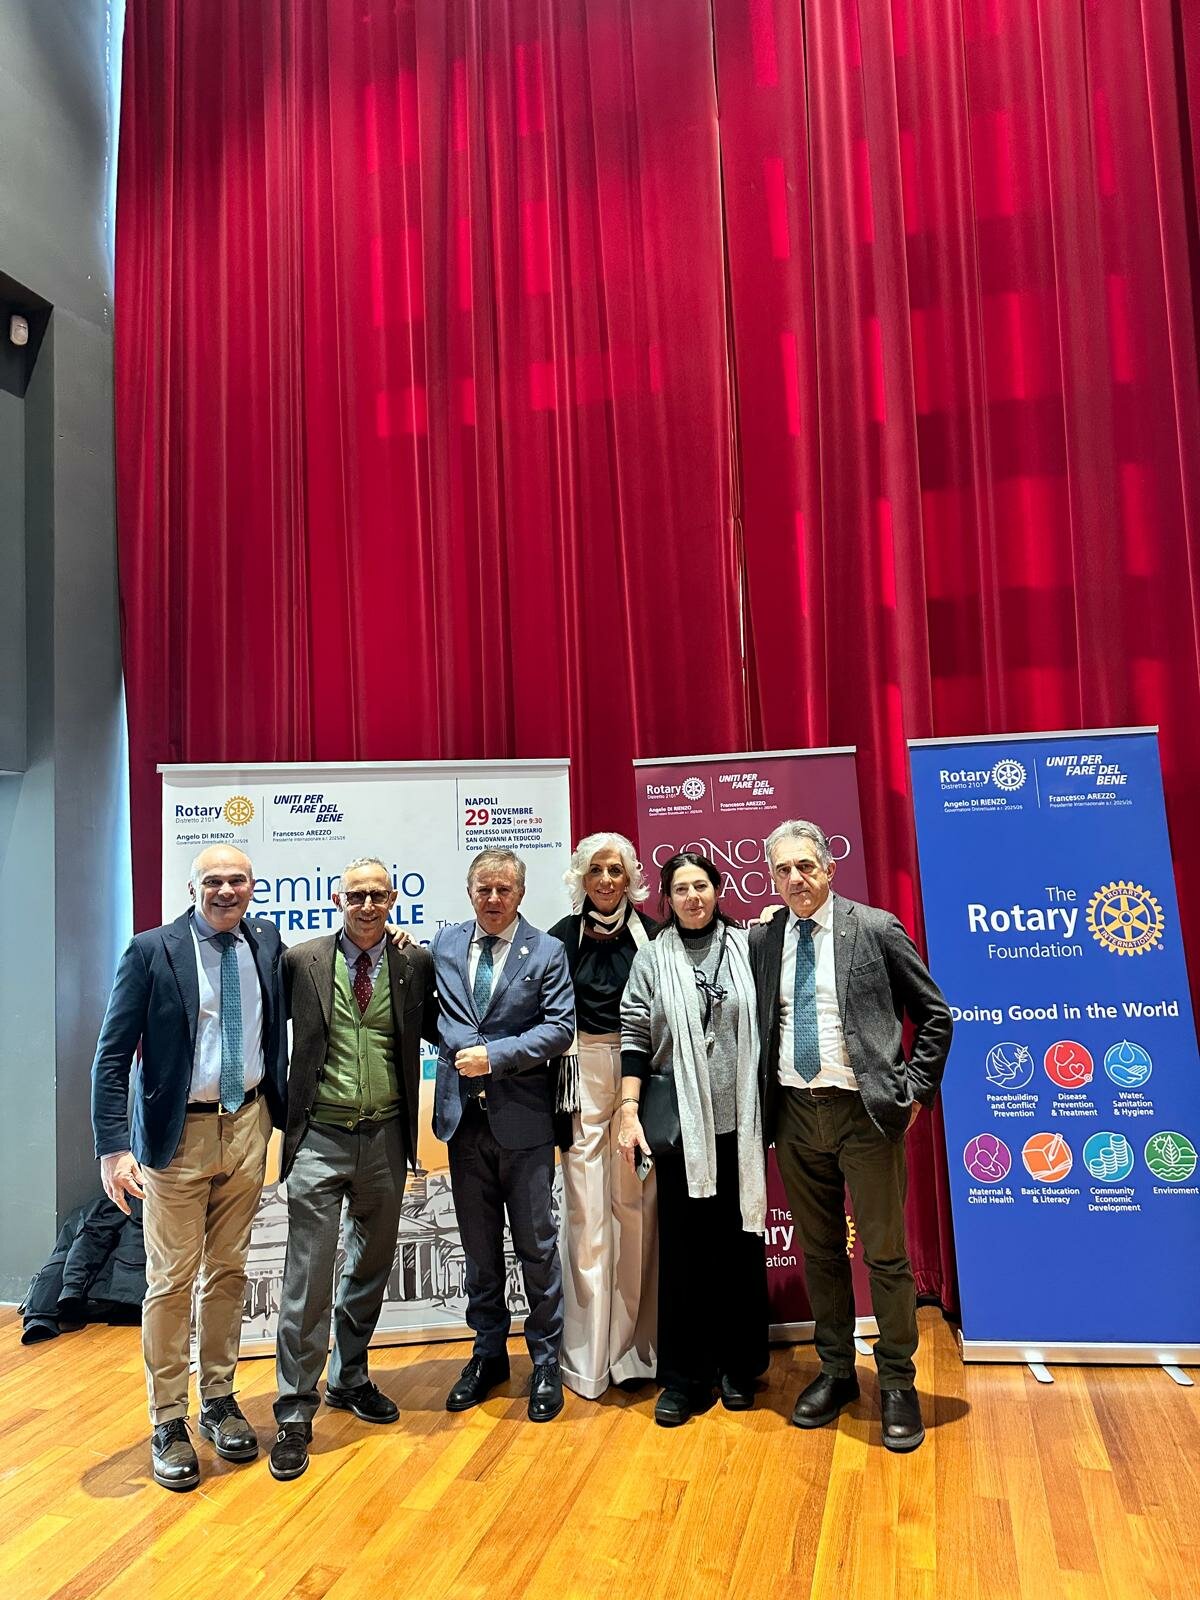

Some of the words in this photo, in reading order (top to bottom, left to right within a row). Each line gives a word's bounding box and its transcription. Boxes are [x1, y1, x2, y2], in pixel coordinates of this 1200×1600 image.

[1046, 755, 1078, 767] UNITI
[1080, 754, 1102, 765] PER
[1066, 765, 1096, 776] FARE
[1098, 764, 1121, 775] DEL
[719, 774, 740, 782] UNITI
[742, 773, 757, 781] PER
[939, 769, 991, 784] Rotary
[1096, 774, 1128, 785] BENE
[646, 784, 682, 795] Rotary
[732, 781, 753, 789] FARE
[754, 780, 770, 788] DEL
[752, 787, 774, 795] BENE
[273, 794, 302, 804] UNITI
[303, 794, 323, 804] PER
[465, 797, 498, 806] NAPOLI
[1049, 794, 1085, 803] Francesco
[1087, 792, 1116, 800] AREZZO
[943, 799, 970, 809] Angelo
[980, 798, 1007, 806] RIENZO
[175, 804, 222, 819] Rotary
[290, 804, 317, 814] FARE
[318, 804, 338, 813] DEL
[315, 813, 344, 822] BENE
[465, 808, 489, 826] 29
[491, 807, 533, 815] NOVEMBRE
[491, 817, 512, 825] 2025
[465, 828, 500, 836] COMPLESSO
[501, 827, 543, 835] UNIVERSITARIO
[176, 833, 200, 841] Angelo
[1045, 886, 1077, 901] The
[1106, 888, 1139, 899] ROTARY
[967, 903, 1079, 939] Rotary
[1100, 928, 1155, 948] INTERNATIONAL
[988, 941, 1083, 959] Foundation
[949, 1006, 1003, 1025] Doing
[1008, 1004, 1058, 1020] Good
[1063, 1003, 1081, 1019] in
[1086, 1002, 1118, 1018] the
[1121, 1001, 1179, 1017] World
[986, 1093, 1039, 1102] Peacebuilding
[1118, 1092, 1145, 1100] Water,
[1122, 1108, 1154, 1117] Hygiene
[1021, 1187, 1040, 1195] Basic
[1089, 1187, 1135, 1196] Community
[1152, 1186, 1200, 1194] Enviroment
[1040, 1195, 1071, 1204] Literacy
[1095, 1195, 1132, 1203] Economic
[1088, 1203, 1142, 1213] Development
[770, 1208, 793, 1221] The
[765, 1253, 797, 1268] ation
